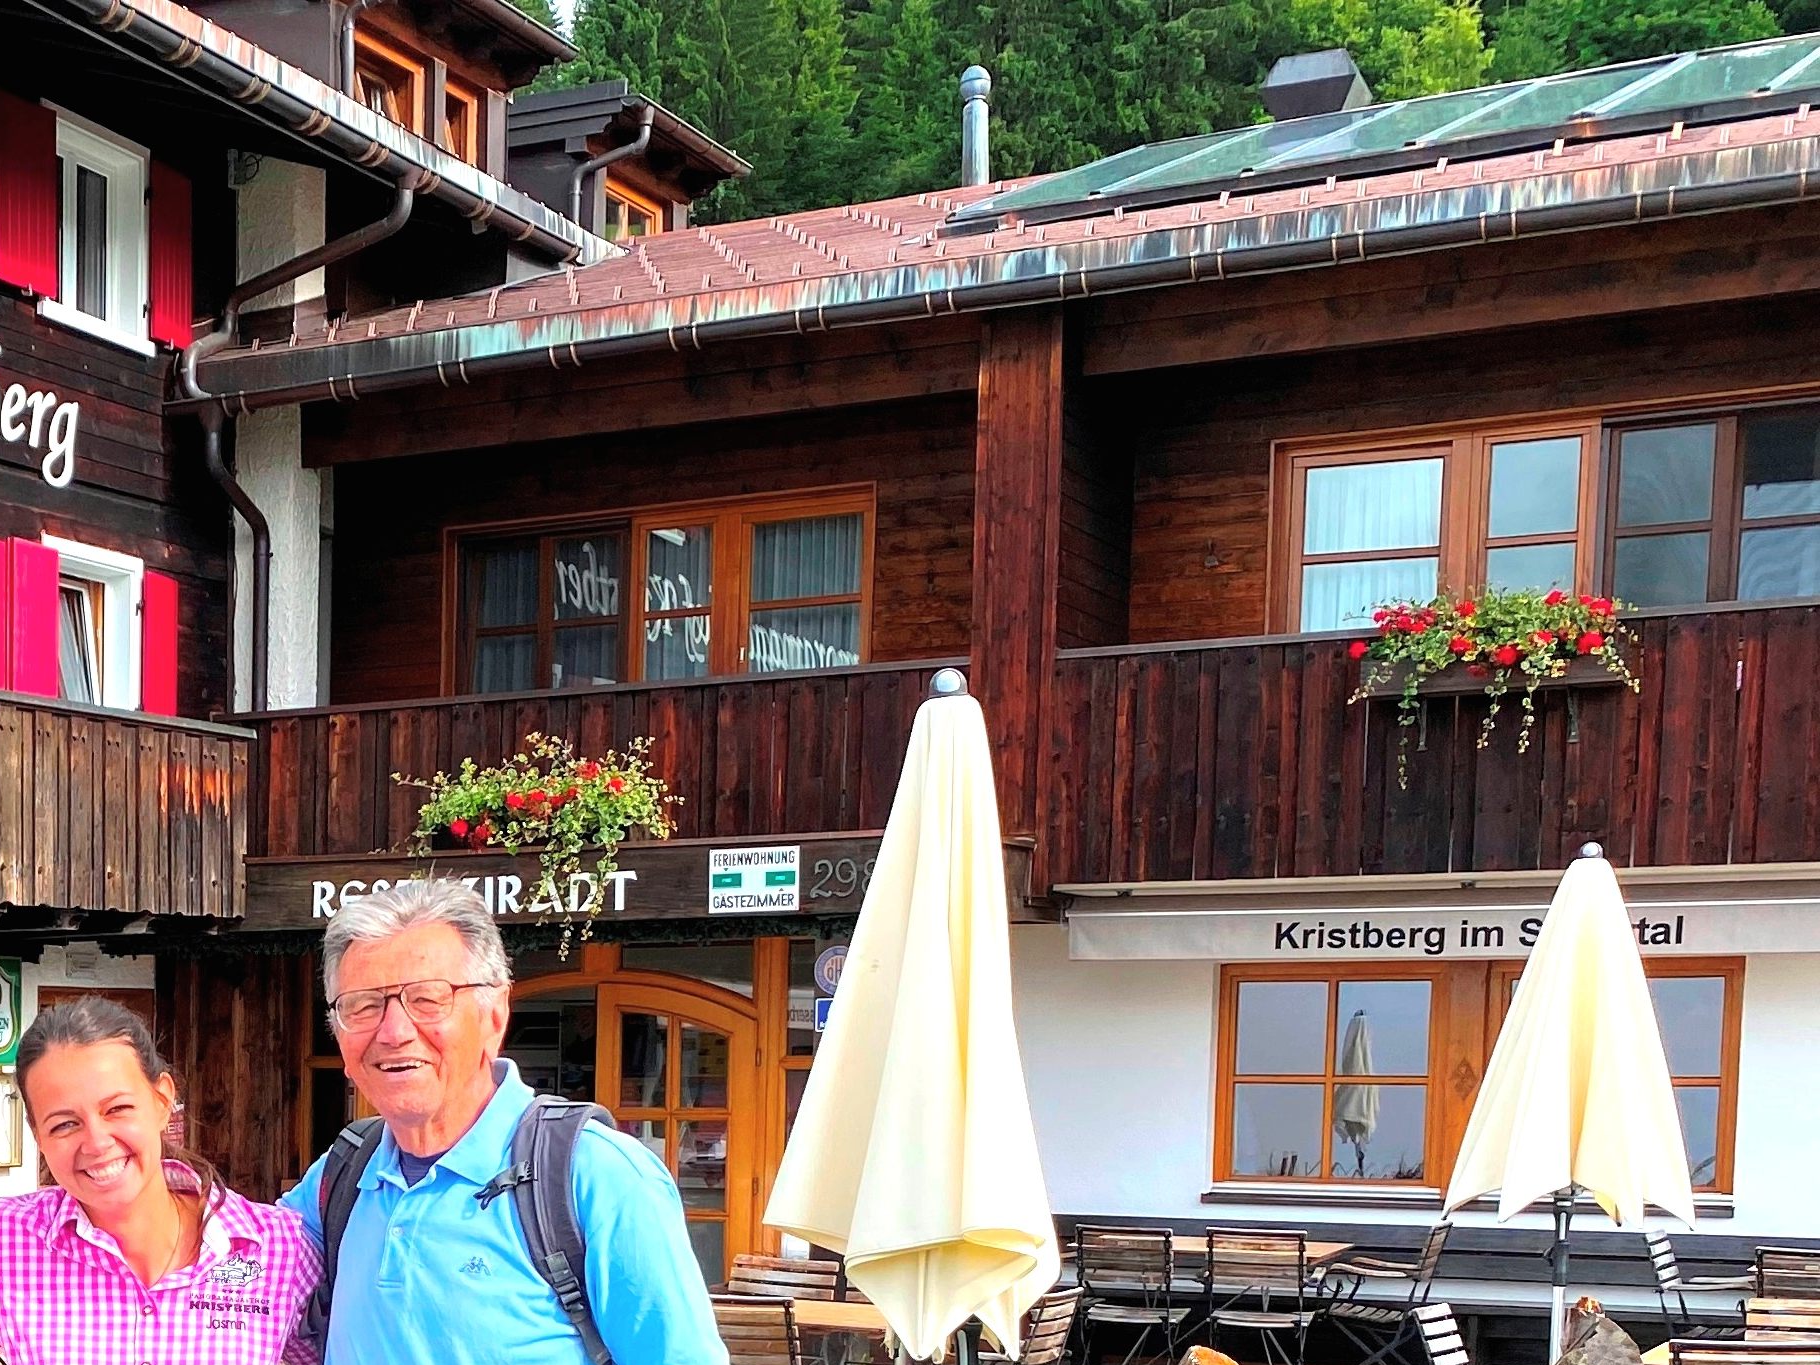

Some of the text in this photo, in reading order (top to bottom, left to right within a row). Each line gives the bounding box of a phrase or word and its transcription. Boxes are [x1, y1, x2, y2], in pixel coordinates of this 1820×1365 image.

[713, 850, 796, 867] FERIENWOHNUNG
[712, 893, 795, 909] GÄSTEZIMMER
[1274, 921, 1447, 956] Kristberg
[1460, 920, 1505, 948] im
[206, 1315, 247, 1331] Jasmin
